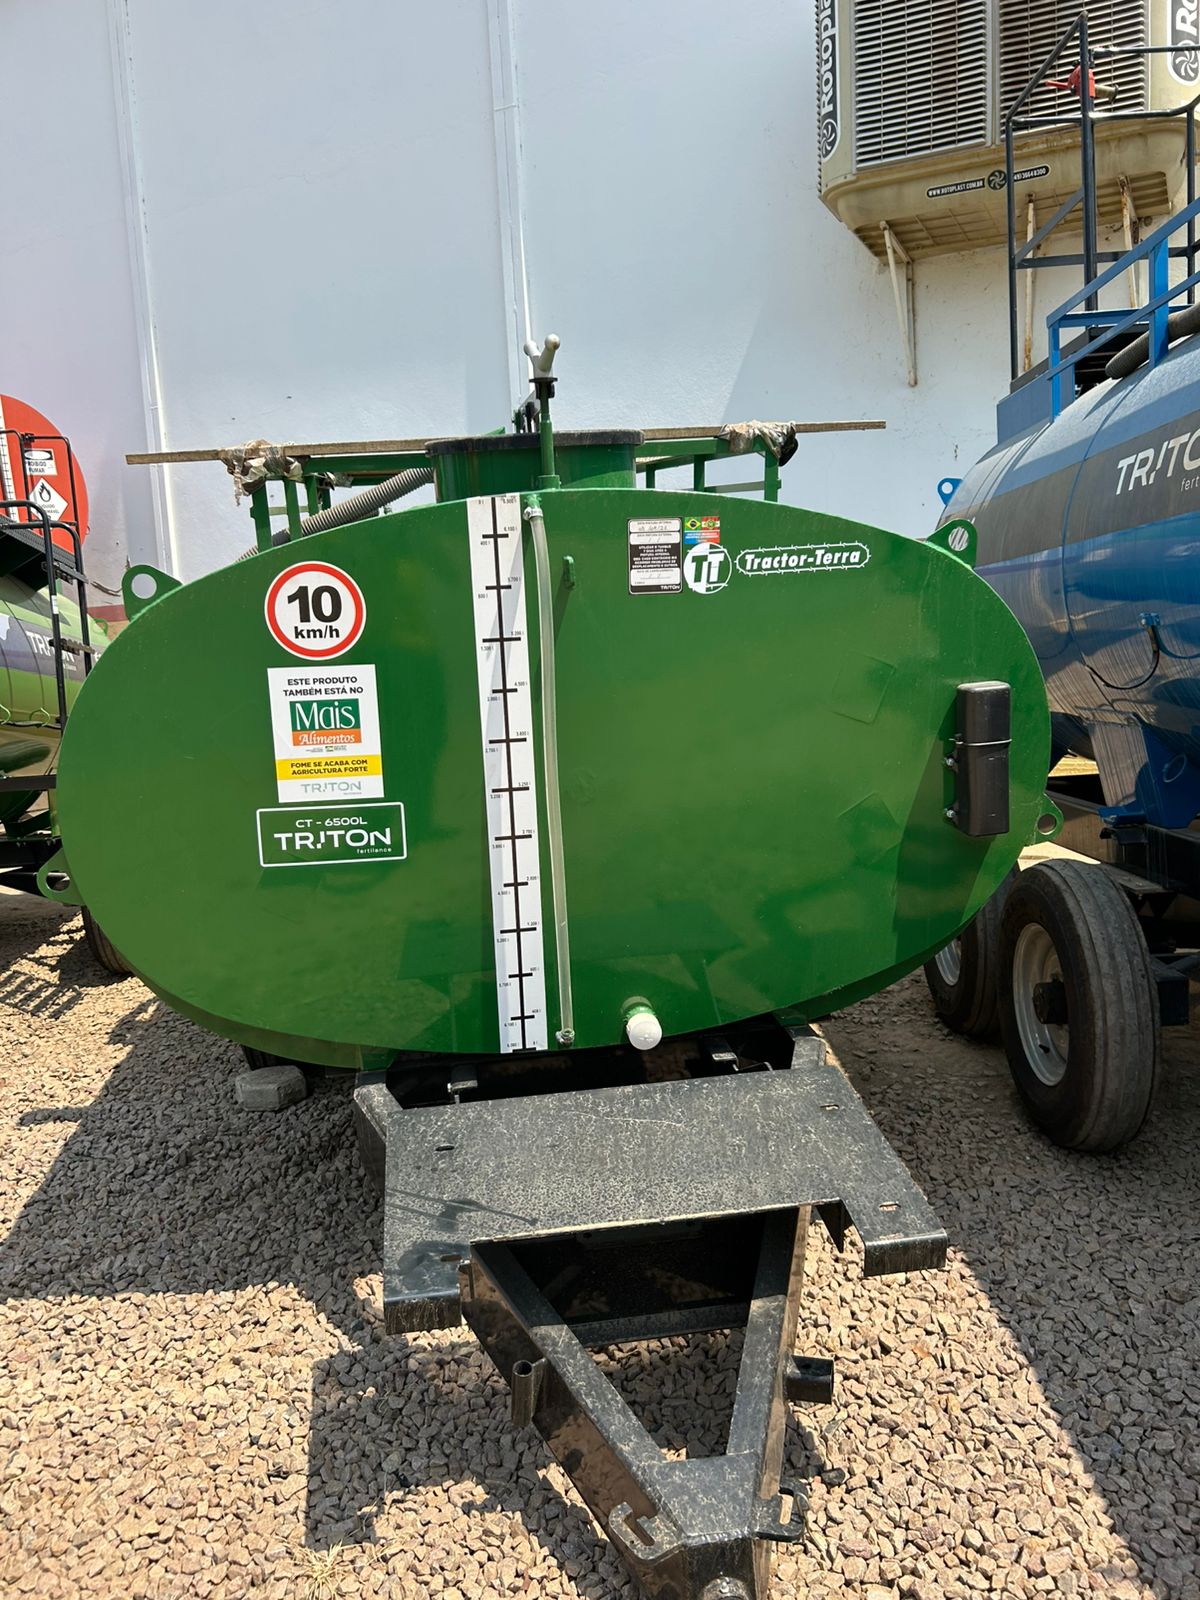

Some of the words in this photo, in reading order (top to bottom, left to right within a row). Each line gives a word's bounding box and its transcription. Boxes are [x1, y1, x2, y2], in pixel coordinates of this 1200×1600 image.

[745, 549, 861, 570] Tractor-Terra
[287, 585, 342, 623] 10
[294, 625, 340, 639] km/h
[312, 676, 358, 685] PRODUTO
[283, 687, 322, 696] TAMBÉM
[324, 686, 348, 695] ESTÁ
[295, 701, 355, 730] Mais
[299, 731, 355, 745] Alimentos
[301, 781, 362, 793] TRITON
[295, 819, 312, 828] CT
[324, 817, 368, 826] 6500L
[274, 828, 392, 850] TRITON
